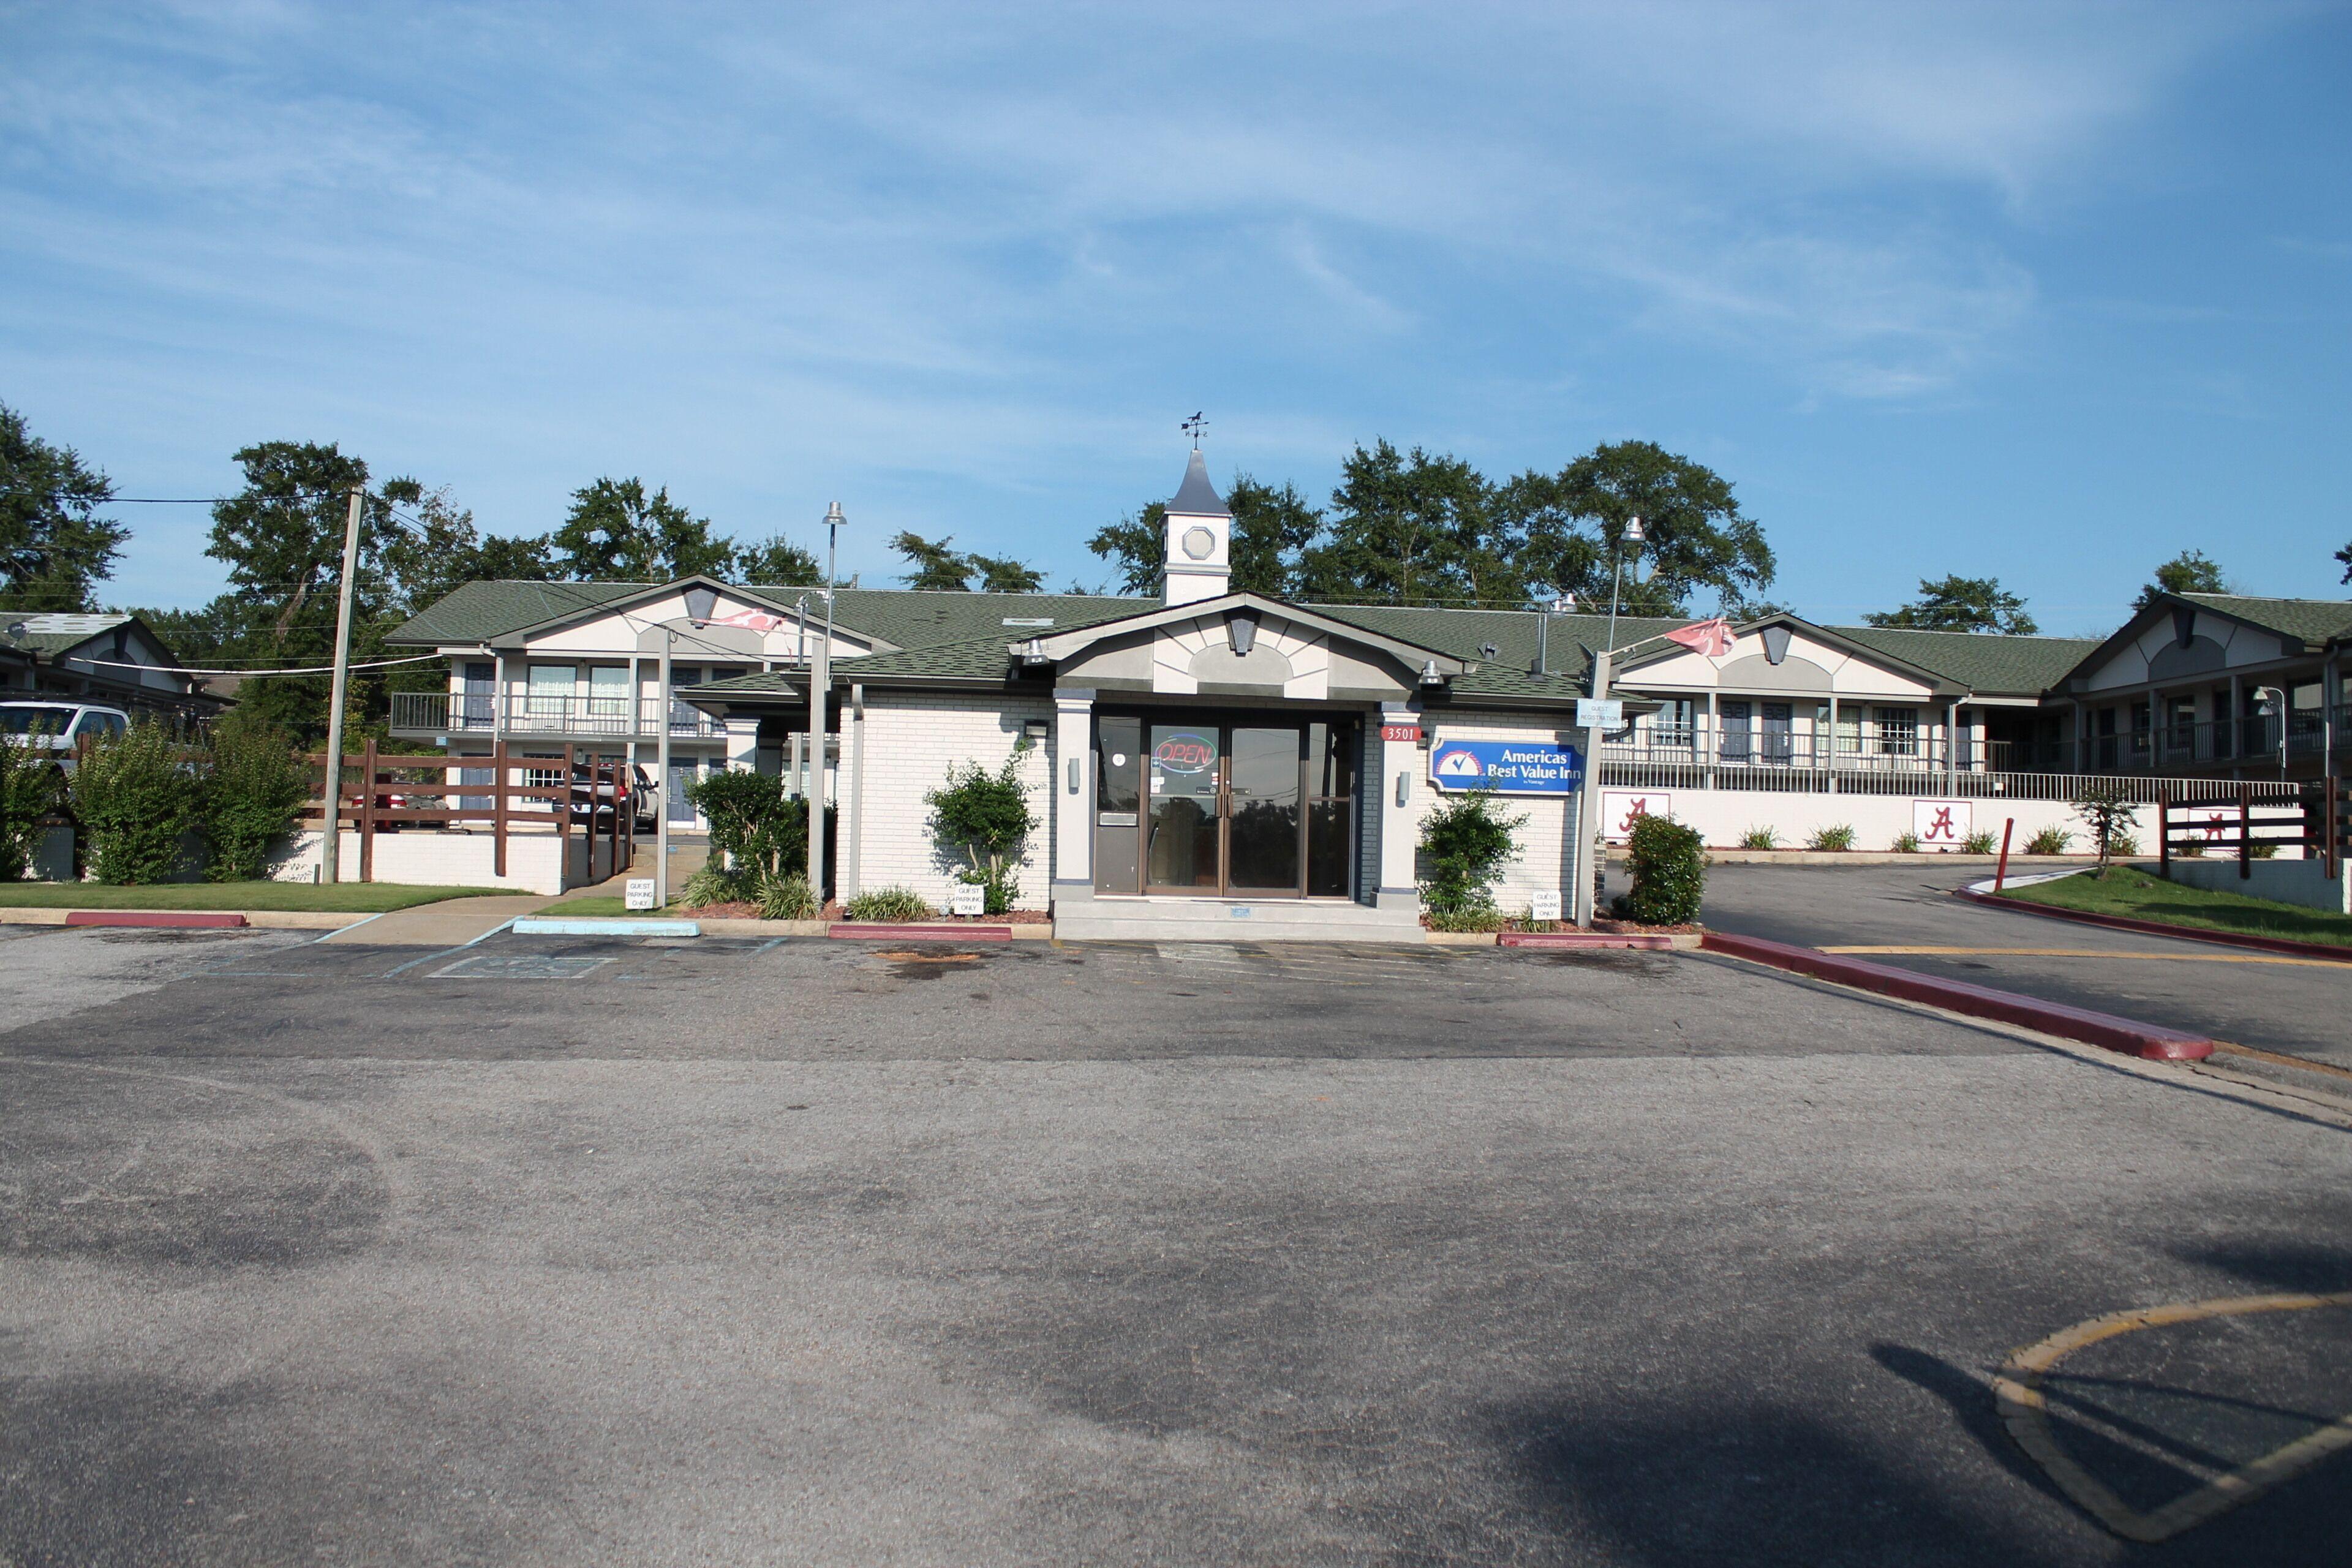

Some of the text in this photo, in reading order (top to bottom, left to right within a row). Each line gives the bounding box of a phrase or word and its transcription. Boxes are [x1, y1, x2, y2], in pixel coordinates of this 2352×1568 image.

[1388, 728, 1414, 740] 3501
[1158, 743, 1212, 764] OPEN
[1501, 749, 1567, 764] Americas
[1520, 765, 1557, 779] Value
[1560, 766, 1581, 780] Inn
[1619, 797, 1650, 832] A
[1924, 806, 1955, 839] A
